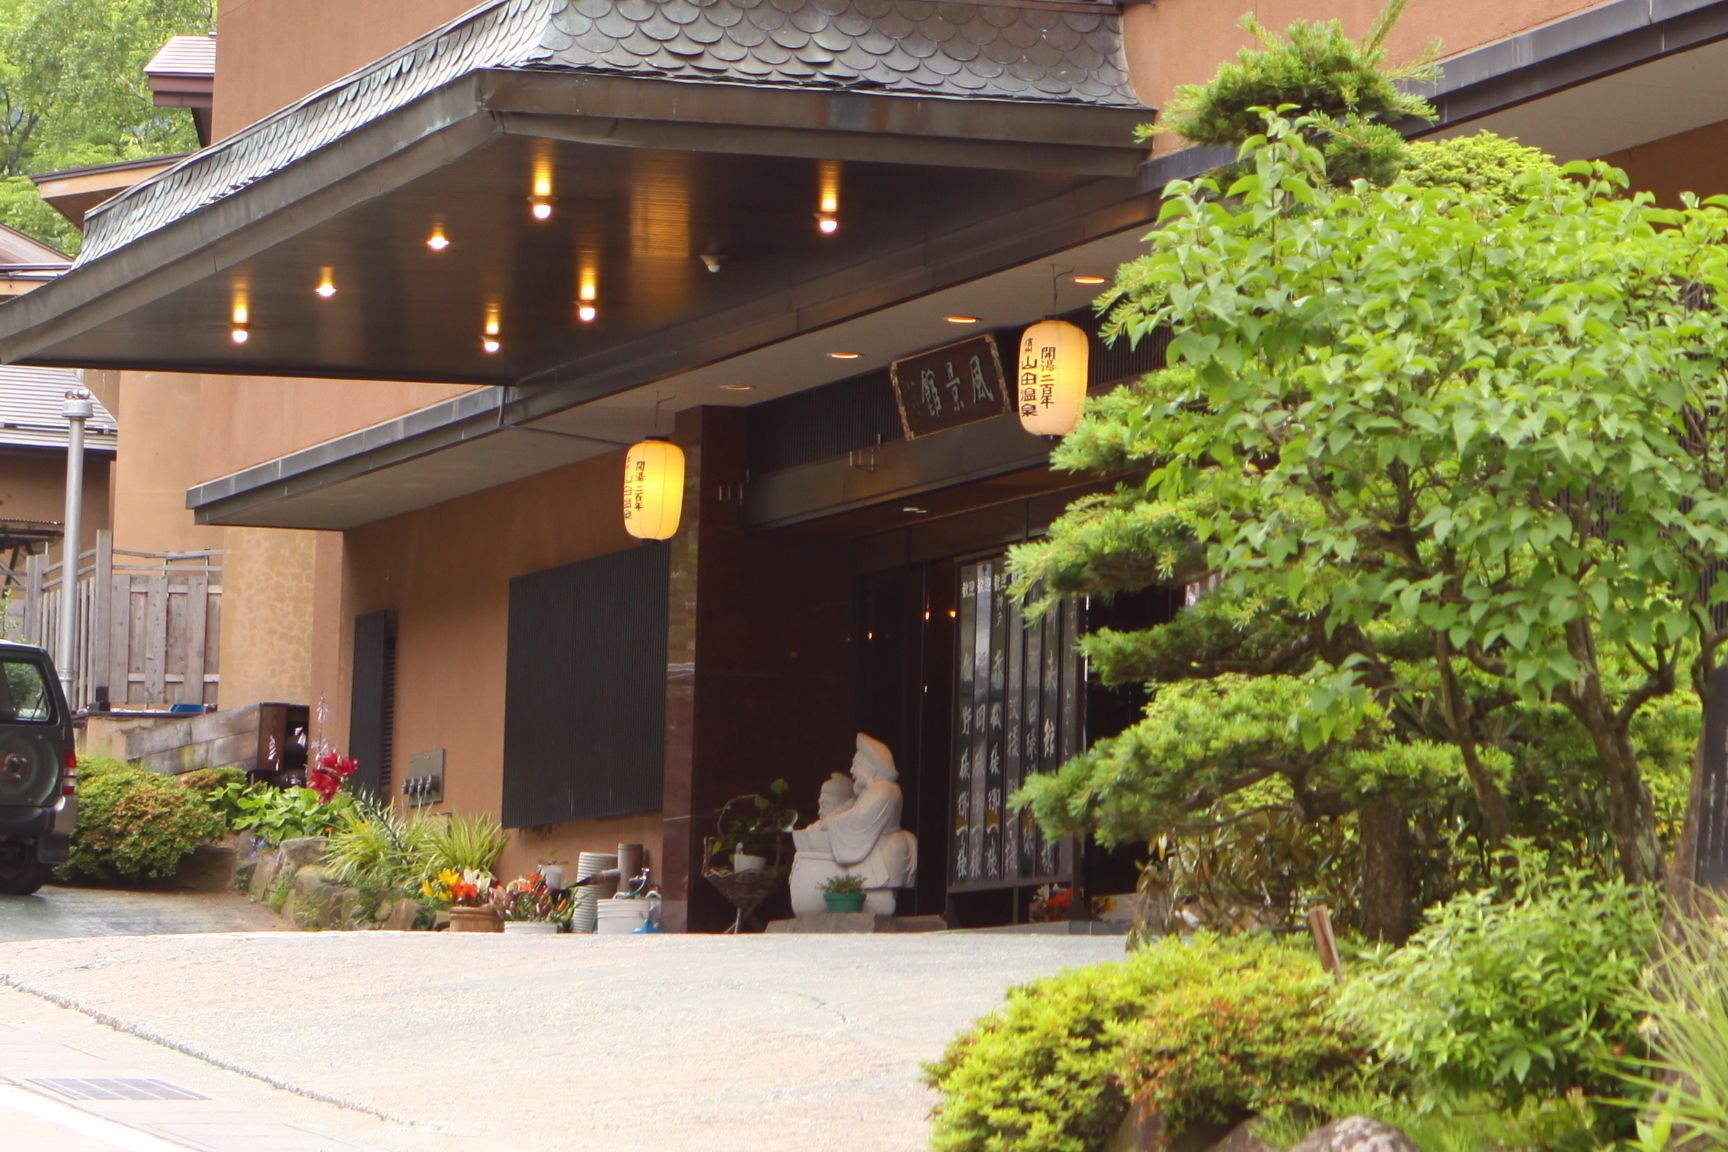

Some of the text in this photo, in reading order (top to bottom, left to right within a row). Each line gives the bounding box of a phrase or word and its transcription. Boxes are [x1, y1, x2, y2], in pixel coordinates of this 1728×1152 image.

[1039, 346, 1057, 410] 開湯二百年
